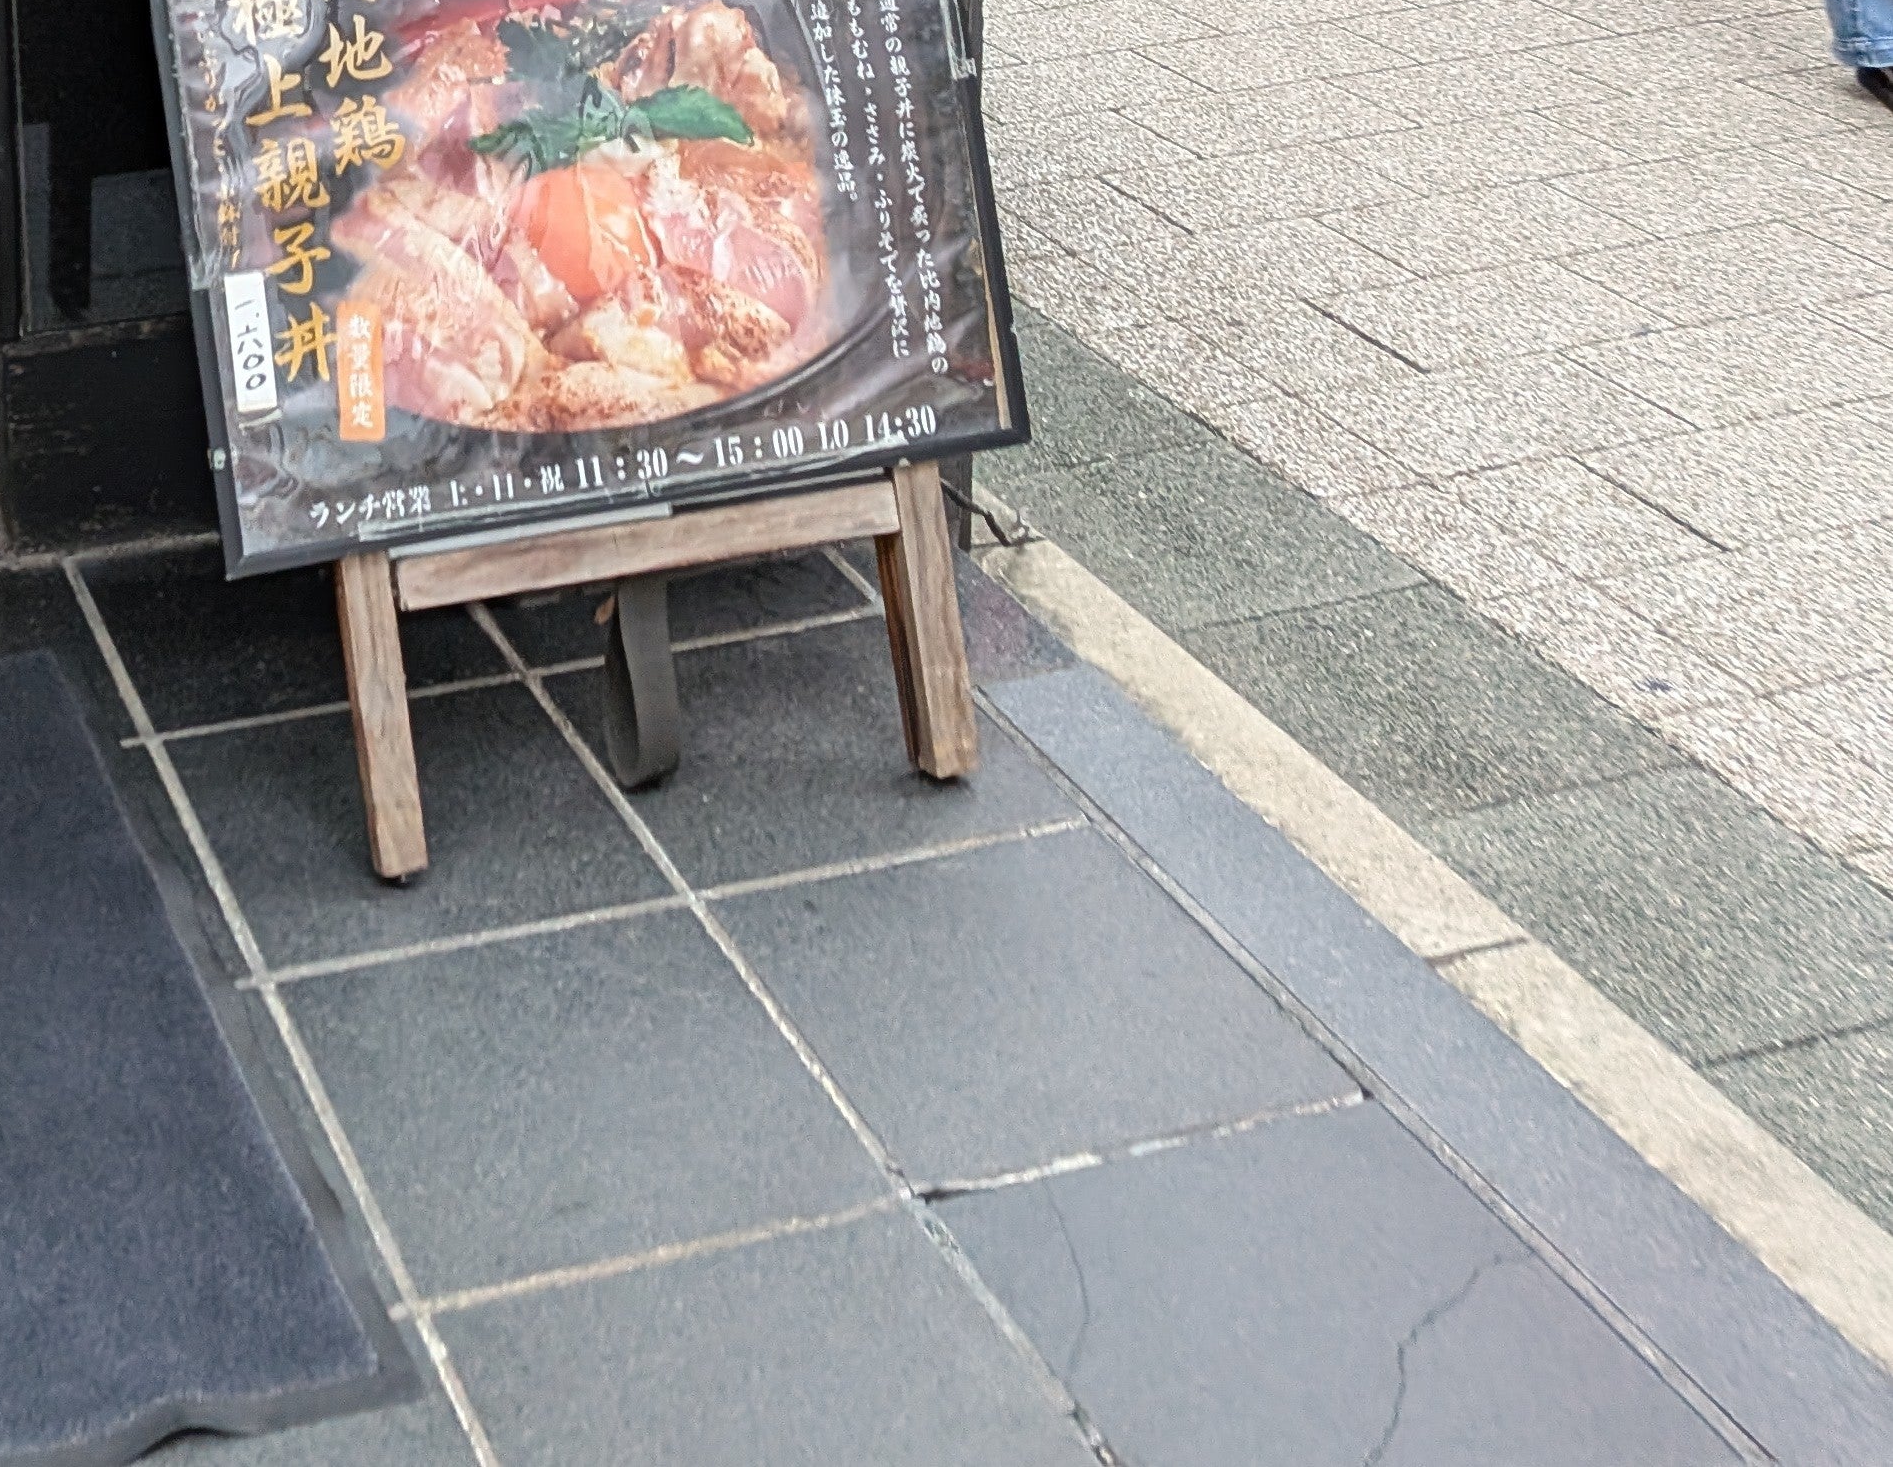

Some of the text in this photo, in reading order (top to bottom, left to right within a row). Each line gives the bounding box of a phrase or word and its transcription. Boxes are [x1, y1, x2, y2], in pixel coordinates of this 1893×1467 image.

[309, 484, 432, 530] ランチ営業
